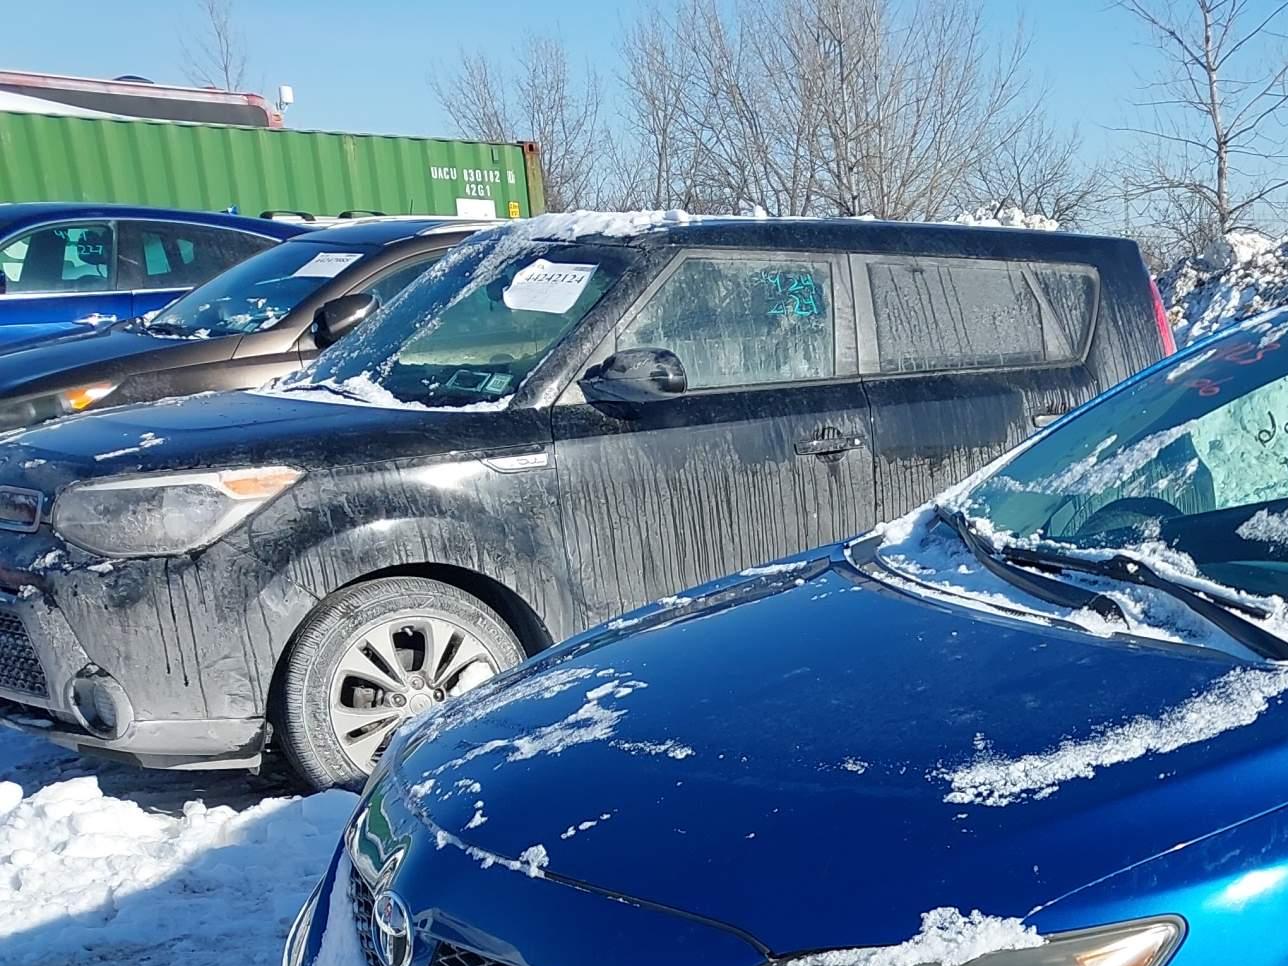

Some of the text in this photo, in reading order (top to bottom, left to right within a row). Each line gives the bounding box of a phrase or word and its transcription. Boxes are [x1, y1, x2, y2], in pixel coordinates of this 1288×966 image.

[431, 166, 457, 180] UACU
[465, 184, 491, 197] 42G1
[526, 272, 585, 284] 44242124
